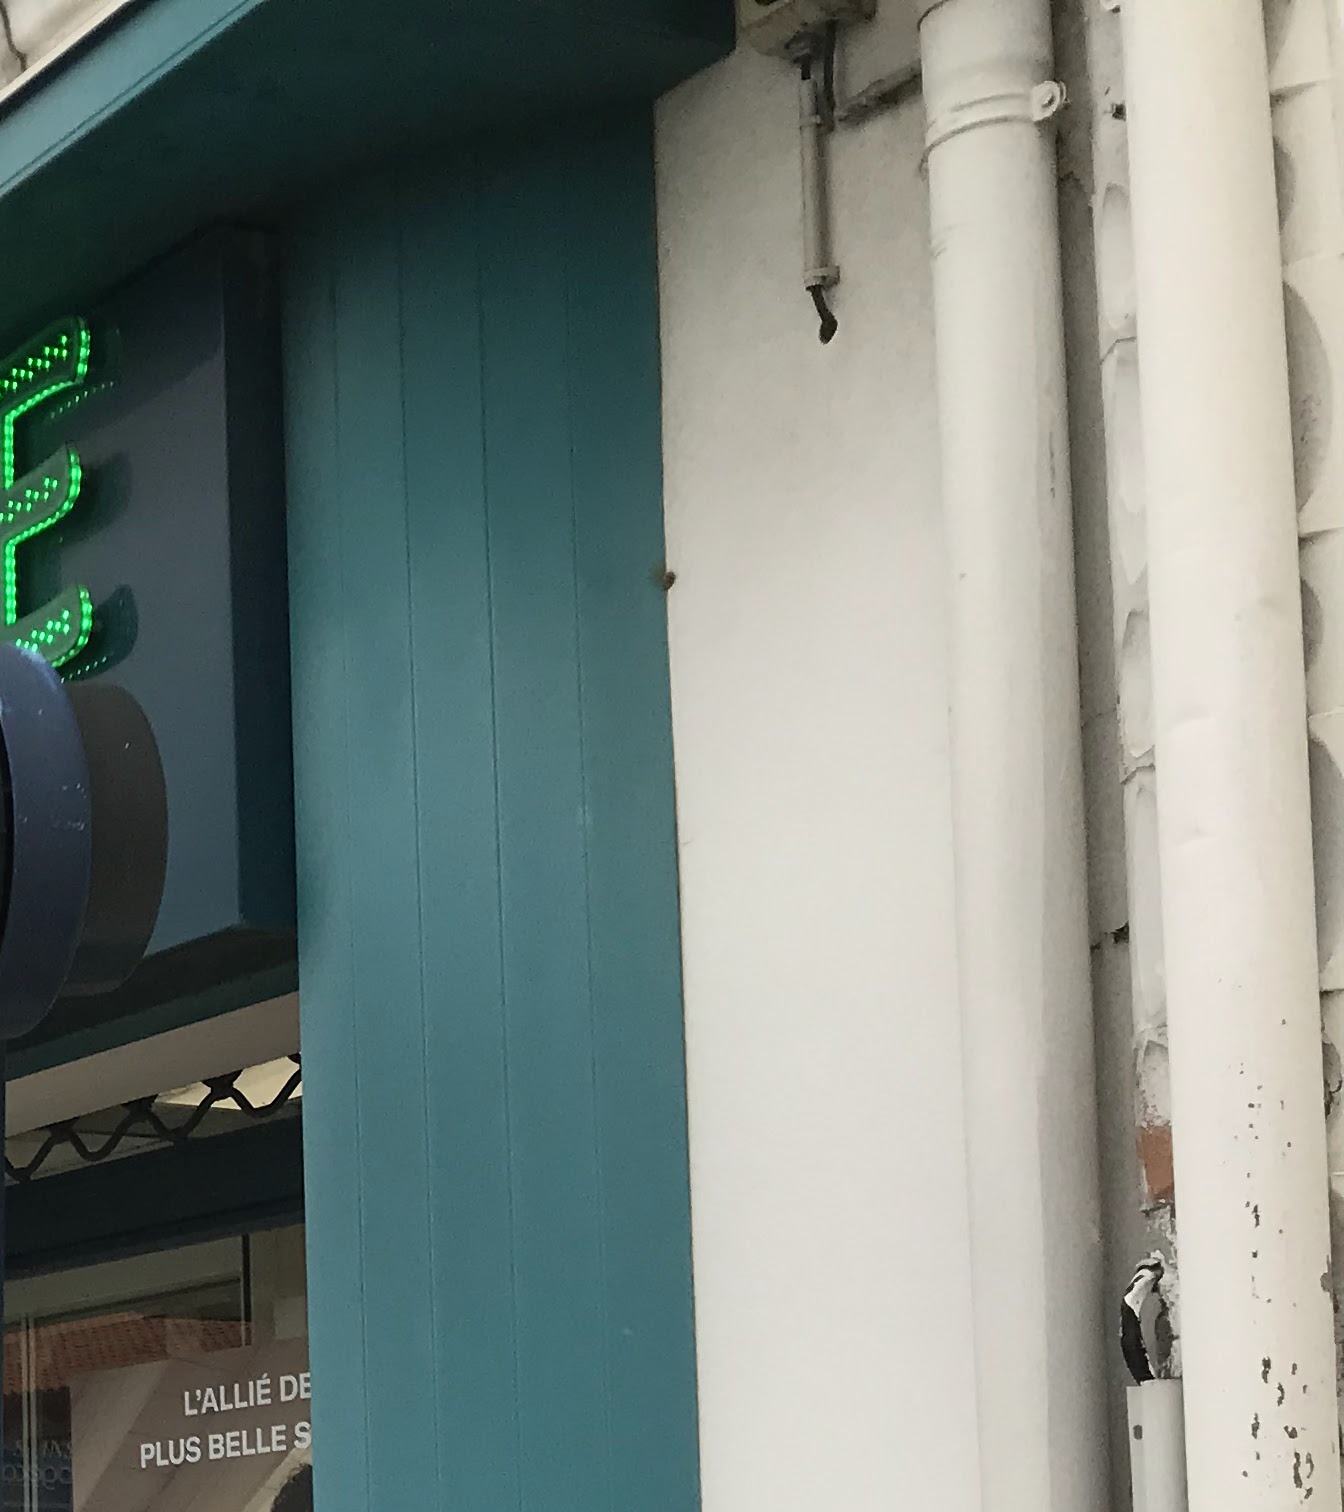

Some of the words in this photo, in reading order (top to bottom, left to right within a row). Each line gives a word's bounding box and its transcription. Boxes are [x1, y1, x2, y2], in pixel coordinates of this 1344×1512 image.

[184, 1373, 271, 1416] L'ALLIÉ
[140, 1436, 201, 1468] PLUS
[208, 1425, 287, 1460] BELLE
